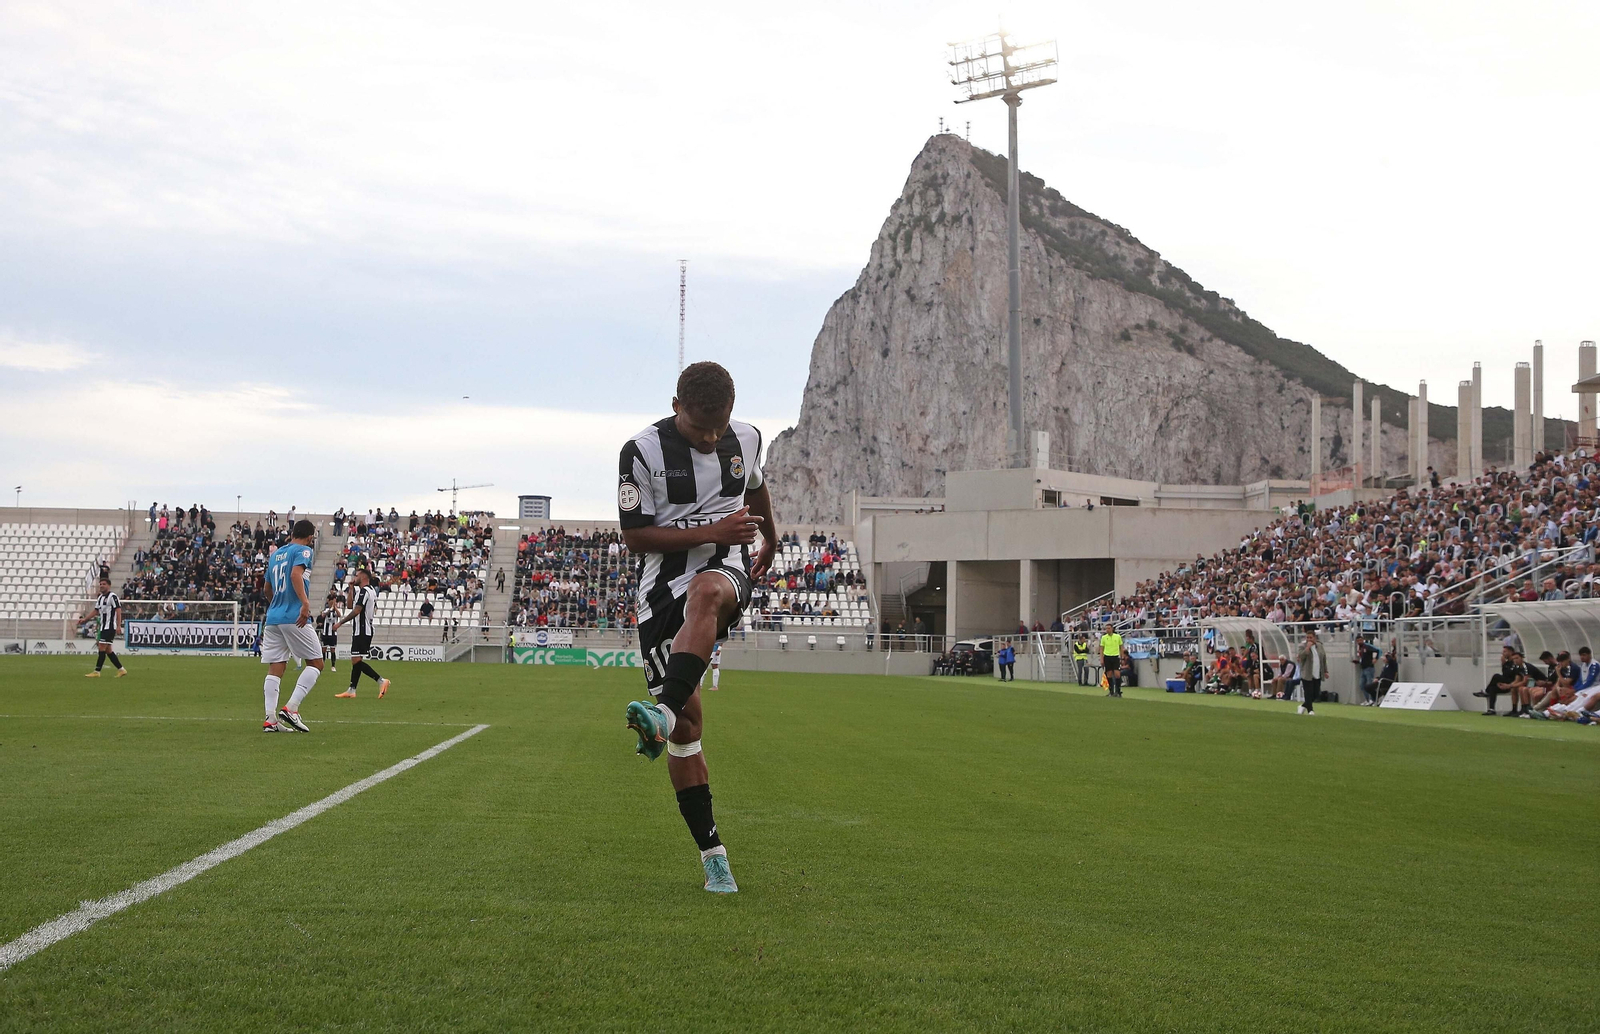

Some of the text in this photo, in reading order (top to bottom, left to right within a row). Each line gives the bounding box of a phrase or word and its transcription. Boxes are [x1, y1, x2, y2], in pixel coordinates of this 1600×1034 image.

[653, 469, 688, 478] LEGEA
[272, 561, 288, 593] 15
[130, 626, 256, 645] BALONADICTOS
[408, 647, 436, 656] Fútbol
[650, 639, 673, 678] 10
